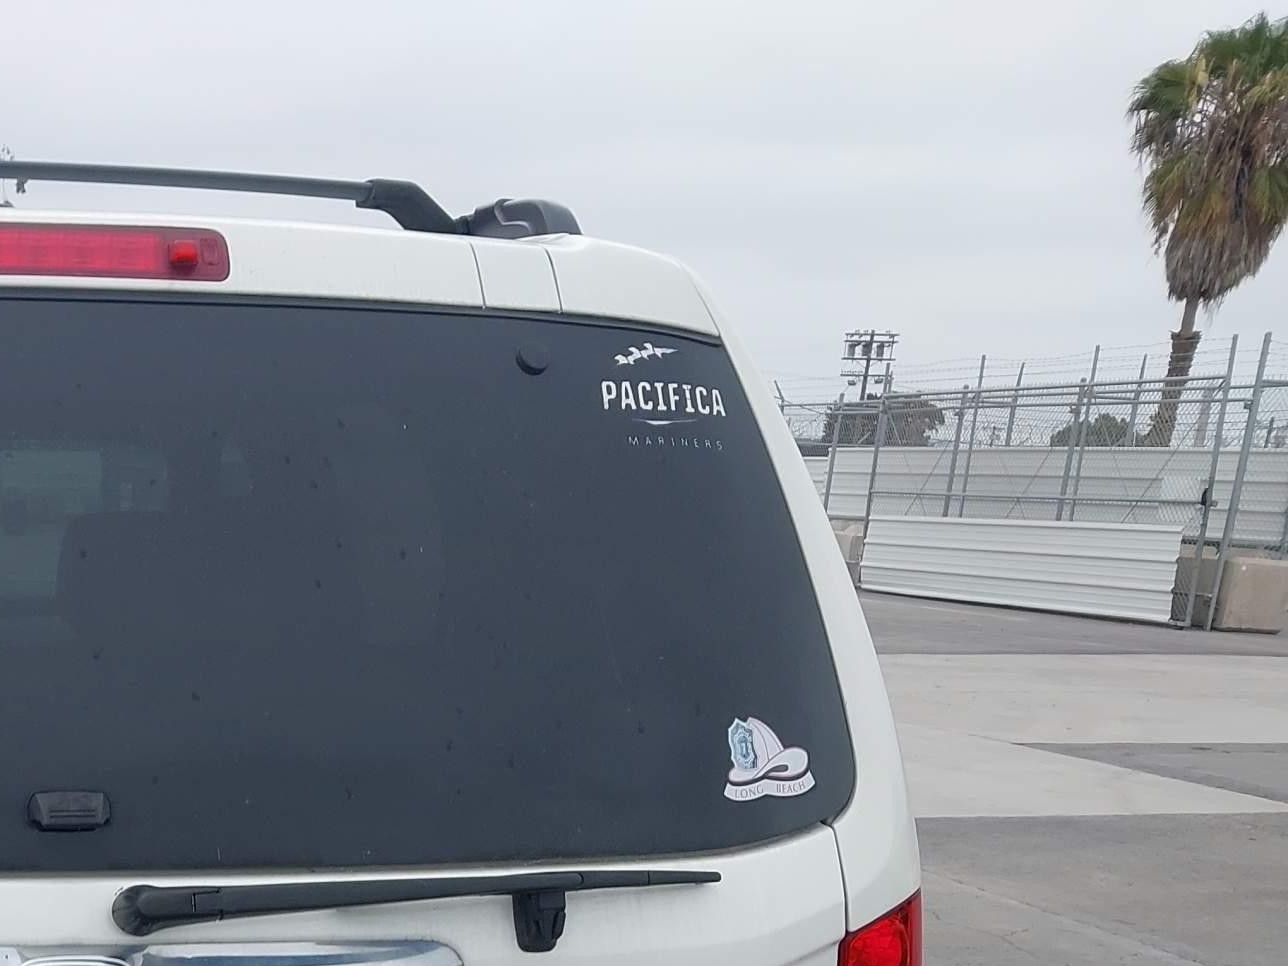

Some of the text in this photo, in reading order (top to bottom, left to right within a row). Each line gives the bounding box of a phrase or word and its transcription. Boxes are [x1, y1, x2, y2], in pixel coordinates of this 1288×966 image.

[601, 380, 727, 417] PACIFICA
[628, 436, 723, 450] MARINERS
[734, 781, 806, 799] LONG BEACH
